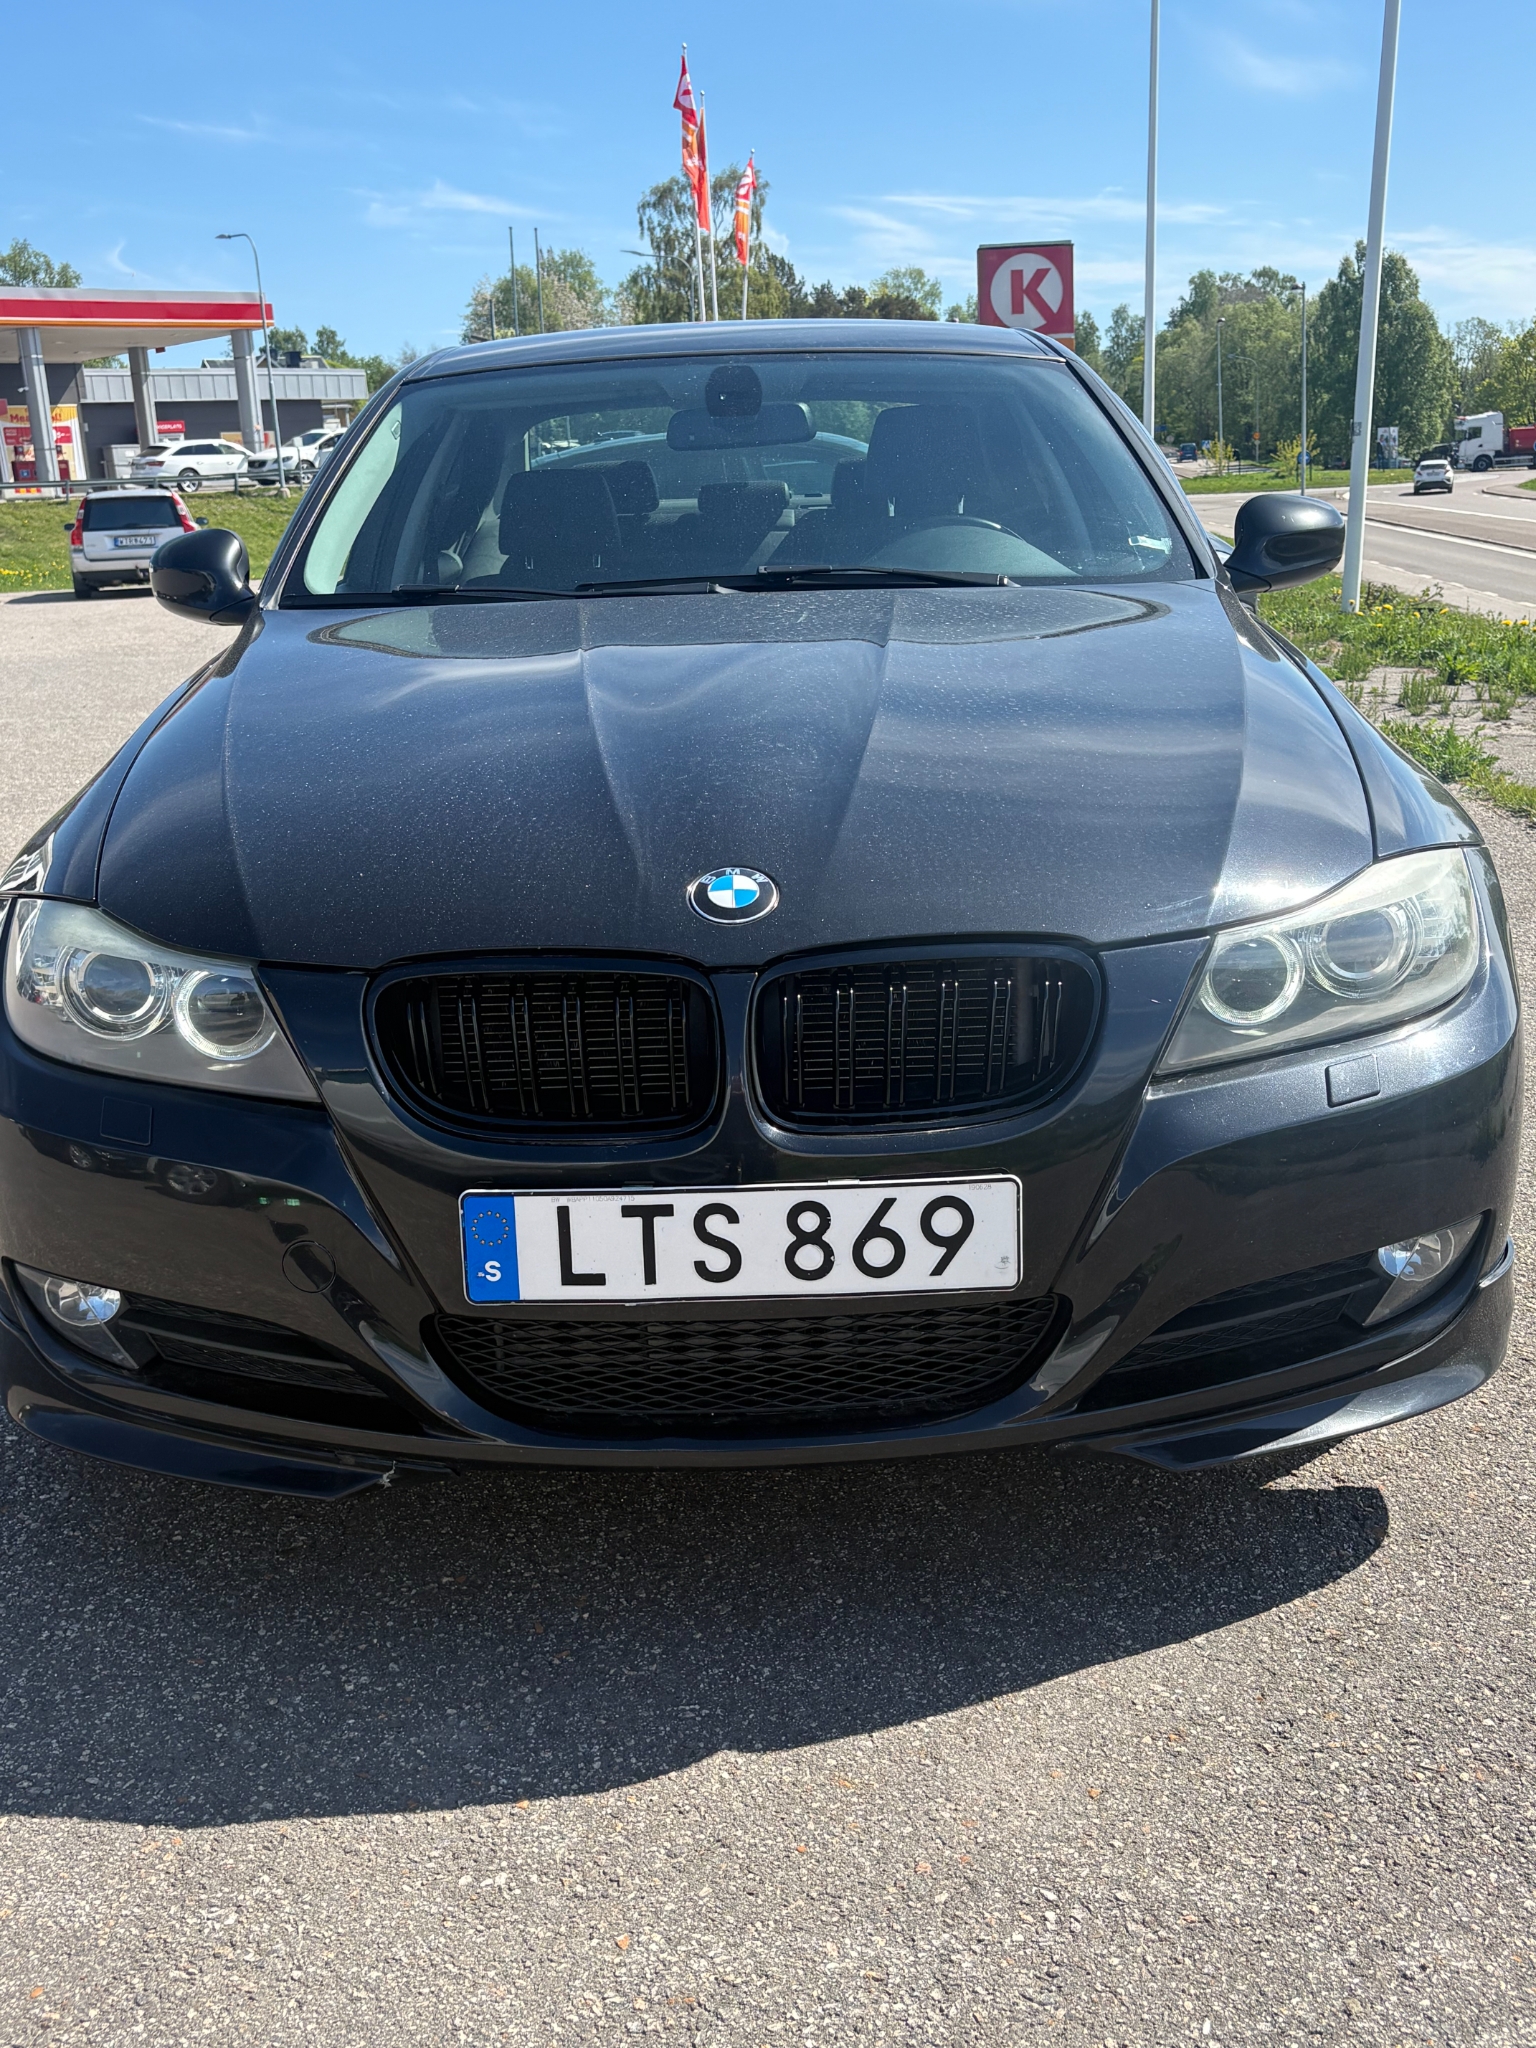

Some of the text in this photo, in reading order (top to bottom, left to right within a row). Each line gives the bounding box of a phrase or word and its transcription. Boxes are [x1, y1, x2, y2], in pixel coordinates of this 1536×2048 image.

[1010, 267, 1055, 323] K
[698, 868, 770, 885] BMW
[556, 1195, 975, 1286] LTS 869
[484, 1260, 502, 1282] S
